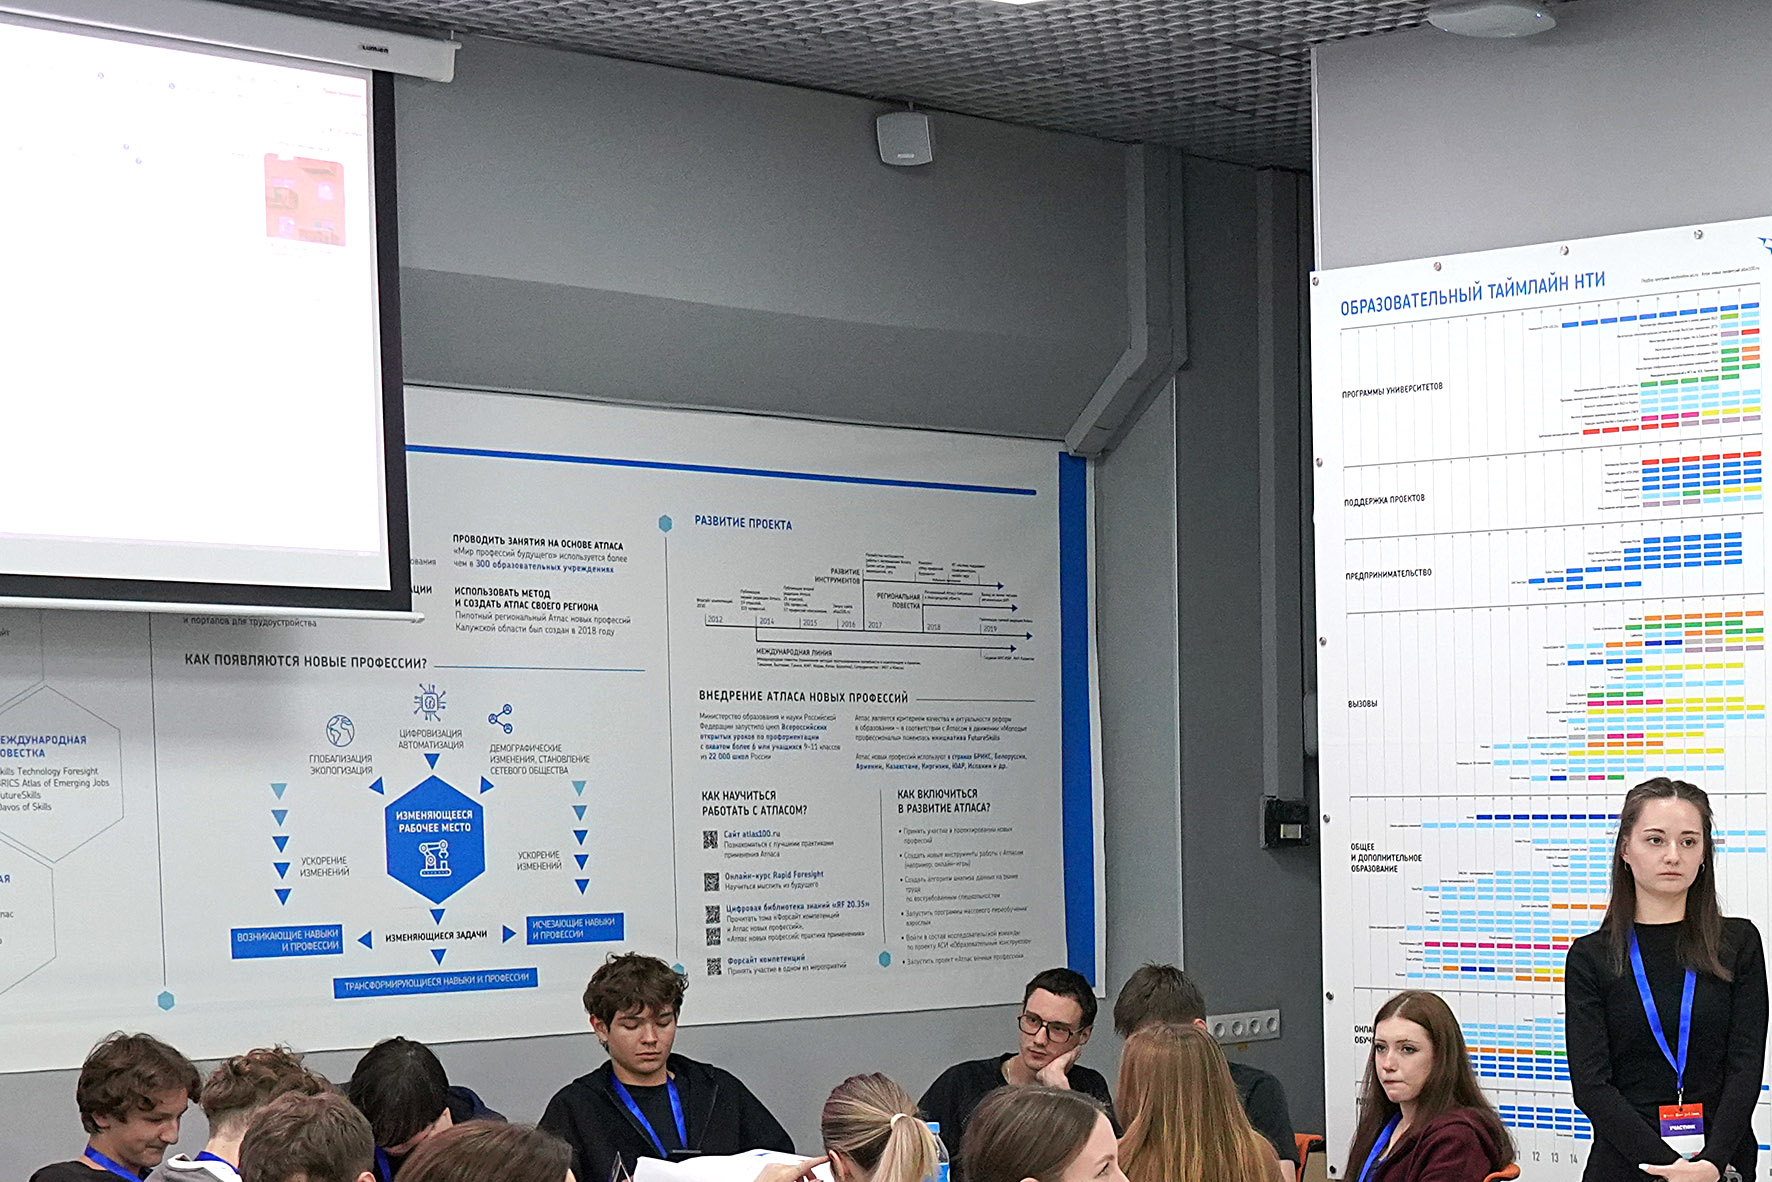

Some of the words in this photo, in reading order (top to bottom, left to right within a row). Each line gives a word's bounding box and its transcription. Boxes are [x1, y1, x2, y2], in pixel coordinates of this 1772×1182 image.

[1341, 280, 1483, 317] ОБРАЗОВАТЕЛЬНЫЙ
[1488, 273, 1569, 300] ТАЙМЛАЙН
[1575, 271, 1606, 290] НТИ
[1342, 388, 1384, 399] ПРОГРАММЫ
[1386, 382, 1443, 395] УНИВЕРСИТЕТОВ
[1344, 497, 1388, 507] ПОДДЕРЖКА
[1390, 494, 1425, 504] ПРОЕКТОВ
[695, 515, 745, 528] РАЗВИТИЕ
[749, 518, 792, 531] ПРОЕКТА
[453, 535, 505, 546] ПРОВОДИТЬ
[508, 537, 545, 547] ЗАНЯТИЯ
[548, 538, 559, 548] НА
[561, 539, 592, 549] ОСНОВЕ
[594, 541, 623, 551] АТЛАСА
[454, 547, 474, 557] «Мир
[476, 548, 515, 559] профессий
[517, 550, 557, 561] будущего»
[559, 553, 605, 562] используется
[607, 553, 628, 563] более
[476, 560, 490, 568] 300
[493, 562, 561, 571] образовательных
[563, 565, 614, 574] учреждениях
[831, 568, 860, 576] РАЗВИТИЕ
[1346, 568, 1432, 581] ПРЕДПРИНИМАТЕЛЬСТВО
[815, 576, 860, 584] ИНСТРУМЕНТОВ
[455, 587, 519, 597] ИСПОЛЬЗОВАТЬ
[522, 589, 551, 599] МЕТОД
[877, 593, 921, 601] РЕГИОНАЛЬНАЯ
[455, 599, 460, 607] И
[464, 599, 501, 609] СОЗДАТЬ
[504, 601, 529, 610] АТЛАС
[531, 602, 561, 610] СВОЕГО
[564, 603, 599, 612] РЕГИОНА
[892, 601, 920, 609] ПОВЕСТКА
[456, 610, 492, 621] Пилотный
[494, 612, 546, 622] региональный
[548, 614, 568, 622] Атлас
[594, 615, 631, 626] профессий
[707, 615, 723, 623] 2012
[759, 617, 774, 625] 2014
[456, 623, 495, 634] Калужской
[498, 624, 526, 633] области
[529, 625, 543, 633] был
[578, 626, 596, 635] 2018
[599, 628, 614, 637] году
[841, 621, 856, 629] 2016
[868, 621, 883, 629] 2017
[927, 623, 941, 631] 2018
[756, 648, 810, 657] МЕЖДУНАРОДНАЯ
[811, 649, 833, 657] ЛИНИЯ
[185, 654, 210, 665] КАК
[215, 654, 300, 667] ПОЯВЛЯЮТСЯ
[304, 656, 347, 668] НОВЫЕ
[351, 657, 427, 669] ПРОФЕССИИ?
[699, 690, 763, 702] ВНЕДРЕНИЕ
[767, 691, 806, 702] АТЛАСА
[809, 692, 845, 703] НОВЫХ
[849, 690, 909, 703] ПРОФЕССИЙ
[1348, 700, 1378, 709] ВЫЗОВЫ
[400, 729, 462, 739] ЦИФРОВИЗАЦИЯ
[398, 740, 464, 750] АВТОМАТИЗАЦИЯ
[490, 744, 562, 753] ДЕМОГРАФИЧЕСКИЕ
[310, 754, 372, 764] ГЛОБАЛИЗАЦИЯ
[490, 755, 536, 764] ИЗМЕНЕНИЯ,
[538, 755, 590, 764] СТАНОВЛЕНИЕ
[310, 766, 372, 776] ЭКОЛОГИЗАЦИЯ
[490, 766, 526, 775] СЕТЕВОГО
[528, 766, 568, 776] ОБЩЕСТВА
[702, 791, 720, 801] КАК
[723, 790, 776, 800] НАУЧИТЬСЯ
[898, 790, 915, 799] КАК
[918, 789, 978, 799] ВКЛЮЧИТЬСЯ
[702, 806, 750, 816] РАБОТАТЬ
[752, 805, 758, 815] С
[761, 805, 807, 815] АТЛАСОМ?
[898, 804, 904, 813] В
[907, 803, 951, 813] РАЗВИТИЕ
[954, 803, 990, 813] АТЛАСА?
[396, 810, 473, 822] ИЗМЕНЯЮЩЕЕСЯ
[399, 823, 439, 833] РАБОЧЕЕ
[442, 822, 471, 832] МЕСТО
[724, 830, 740, 838] Сайт
[742, 830, 780, 838] atlas100.ru
[1351, 843, 1375, 852] ОБЩЕЕ
[518, 850, 560, 860] УСКОРЕНИЕ
[1351, 854, 1356, 862] И
[1358, 854, 1422, 863] ДОПОЛНИТЕЛЬНОЕ
[302, 856, 347, 865] УСКОРЕНИЕ
[517, 860, 562, 871] ИЗМЕНЕНИЙ
[300, 866, 350, 877] ИЗМЕНЕНИЙ
[1351, 865, 1398, 873] ОБРАЗОВАНИЕ
[725, 872, 771, 880] Онлайн-курс
[773, 871, 792, 880] Rapid
[794, 870, 824, 880] Foresight
[532, 918, 584, 930] ИСЧЕЗАЮЩИЕ
[585, 916, 615, 927] НАВЫКИ
[237, 931, 303, 943] ВОЗНИКАЮЩИЕ
[305, 929, 338, 940] НАВЫКИ
[385, 932, 454, 944] ИЗМЕНЯЮЩИЕСЯ
[456, 929, 488, 941] ЗАДАЧИ
[533, 930, 539, 939] И
[541, 929, 584, 939] ПРОФЕССИИ
[281, 943, 288, 952] И
[290, 941, 339, 952] ПРОФЕССИИ
[345, 977, 442, 992] ТРАНСФОРМИРУЮЩИЕСЯ
[443, 975, 476, 986] НАВЫКИ
[477, 974, 483, 983] И
[485, 972, 530, 983] ПРОФЕССИИ
[1532, 1152, 1540, 1162] 12
[1551, 1153, 1559, 1163] 13
[1570, 1154, 1578, 1164] 14
